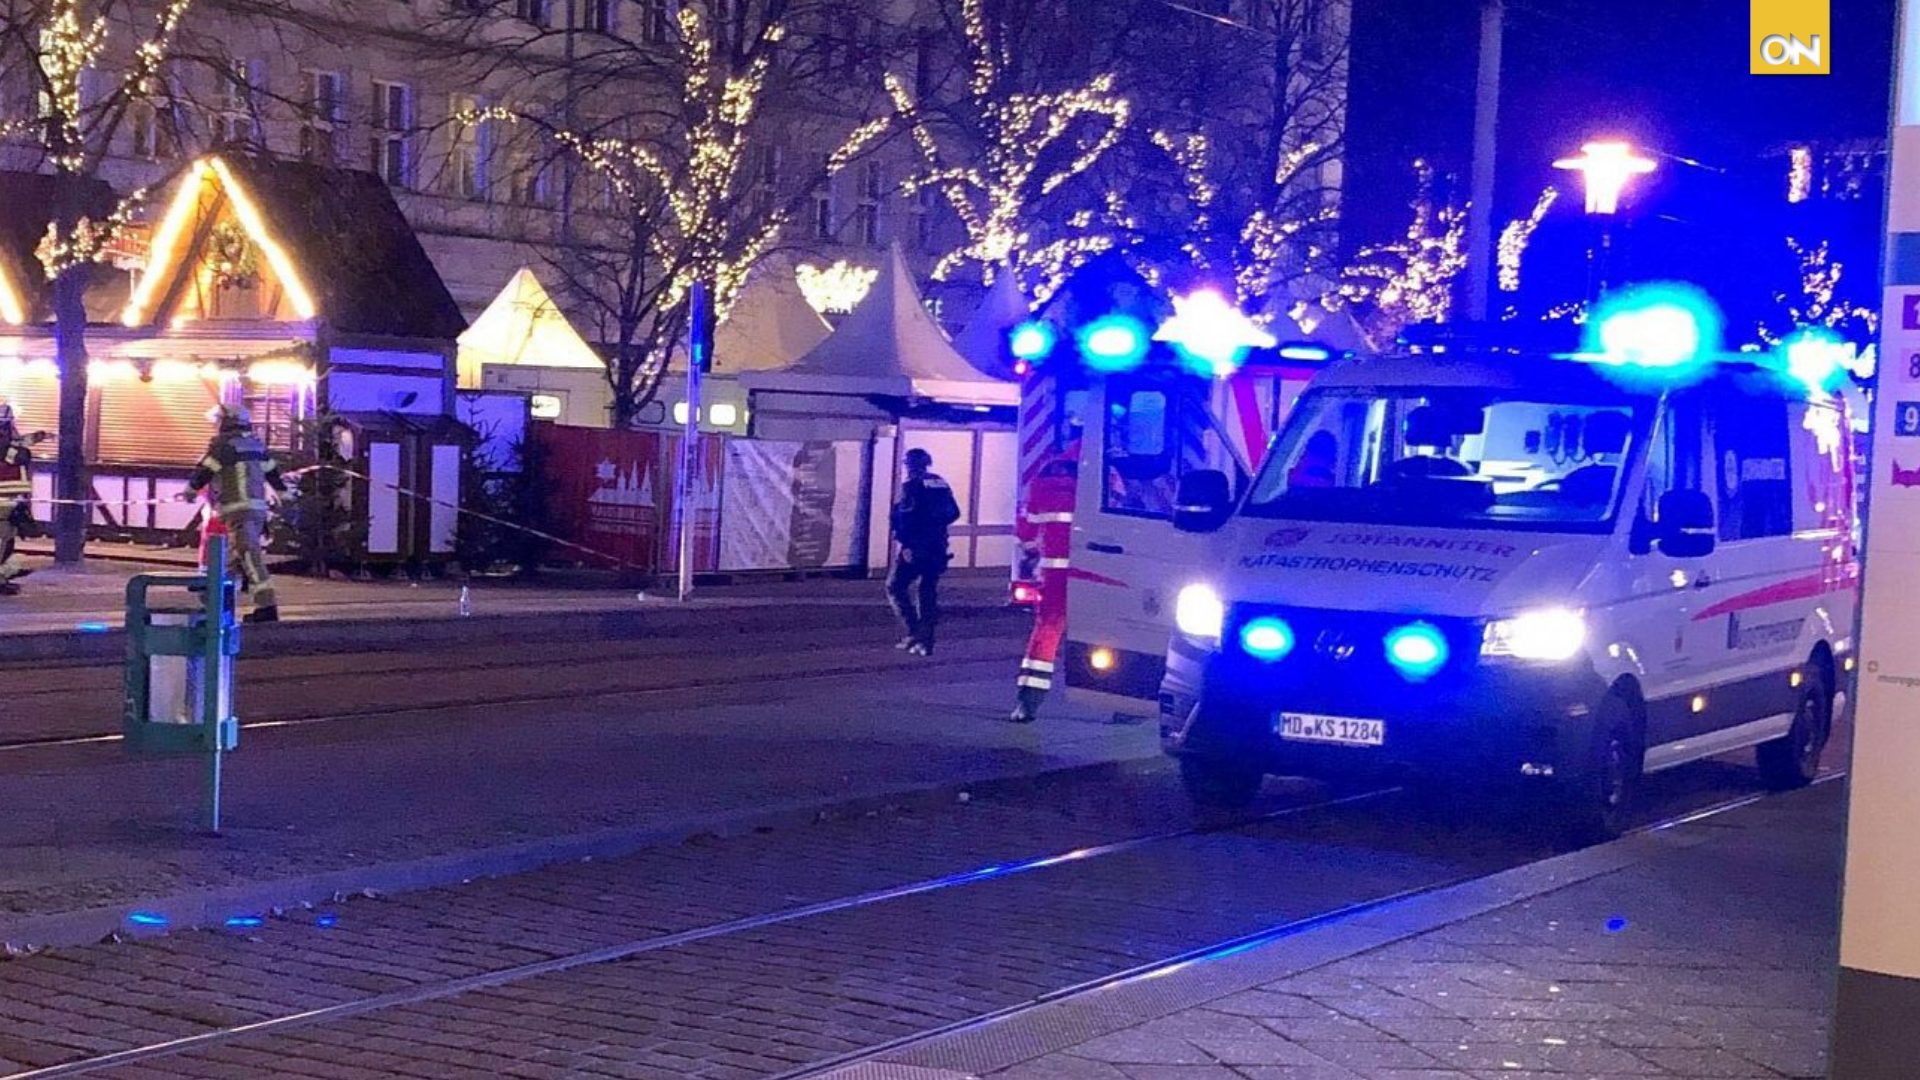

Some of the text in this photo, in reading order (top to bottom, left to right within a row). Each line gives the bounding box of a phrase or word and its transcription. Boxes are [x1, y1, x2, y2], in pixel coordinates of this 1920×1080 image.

[1909, 353, 1920, 379] 8
[1904, 406, 1919, 433] 9
[1323, 532, 1516, 558] JOHANNITER
[1238, 554, 1498, 582] KATASTROPHENSCHUTZ
[1281, 715, 1380, 741] MD KS 1284
